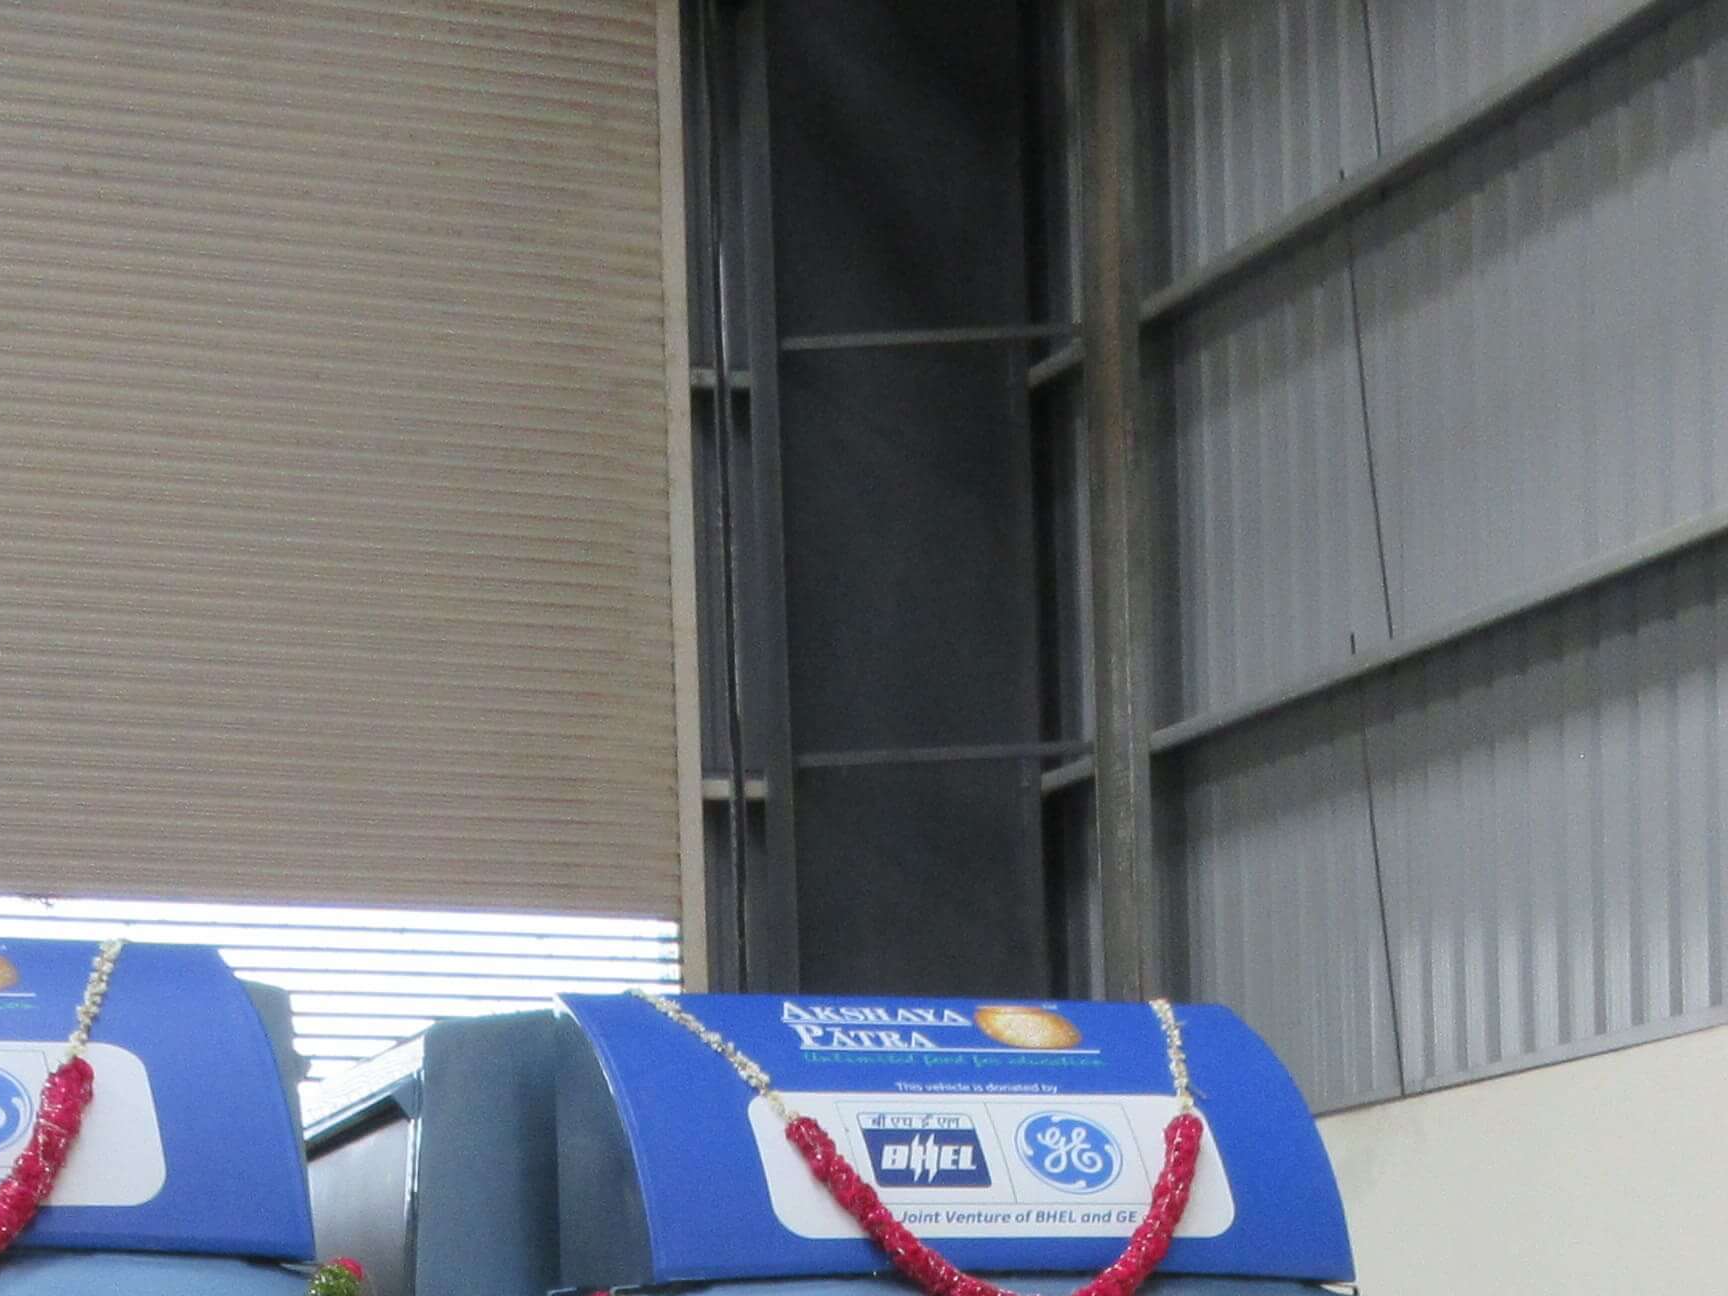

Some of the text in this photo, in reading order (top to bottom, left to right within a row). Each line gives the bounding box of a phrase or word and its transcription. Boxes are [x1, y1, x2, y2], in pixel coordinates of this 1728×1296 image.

[781, 1000, 972, 1025] AKSHAYA
[895, 1082, 1058, 1095] This vehicle is donated by
[880, 1133, 977, 1183] BHEL
[899, 1210, 1139, 1225] Joint Venture of BHEL and GE
